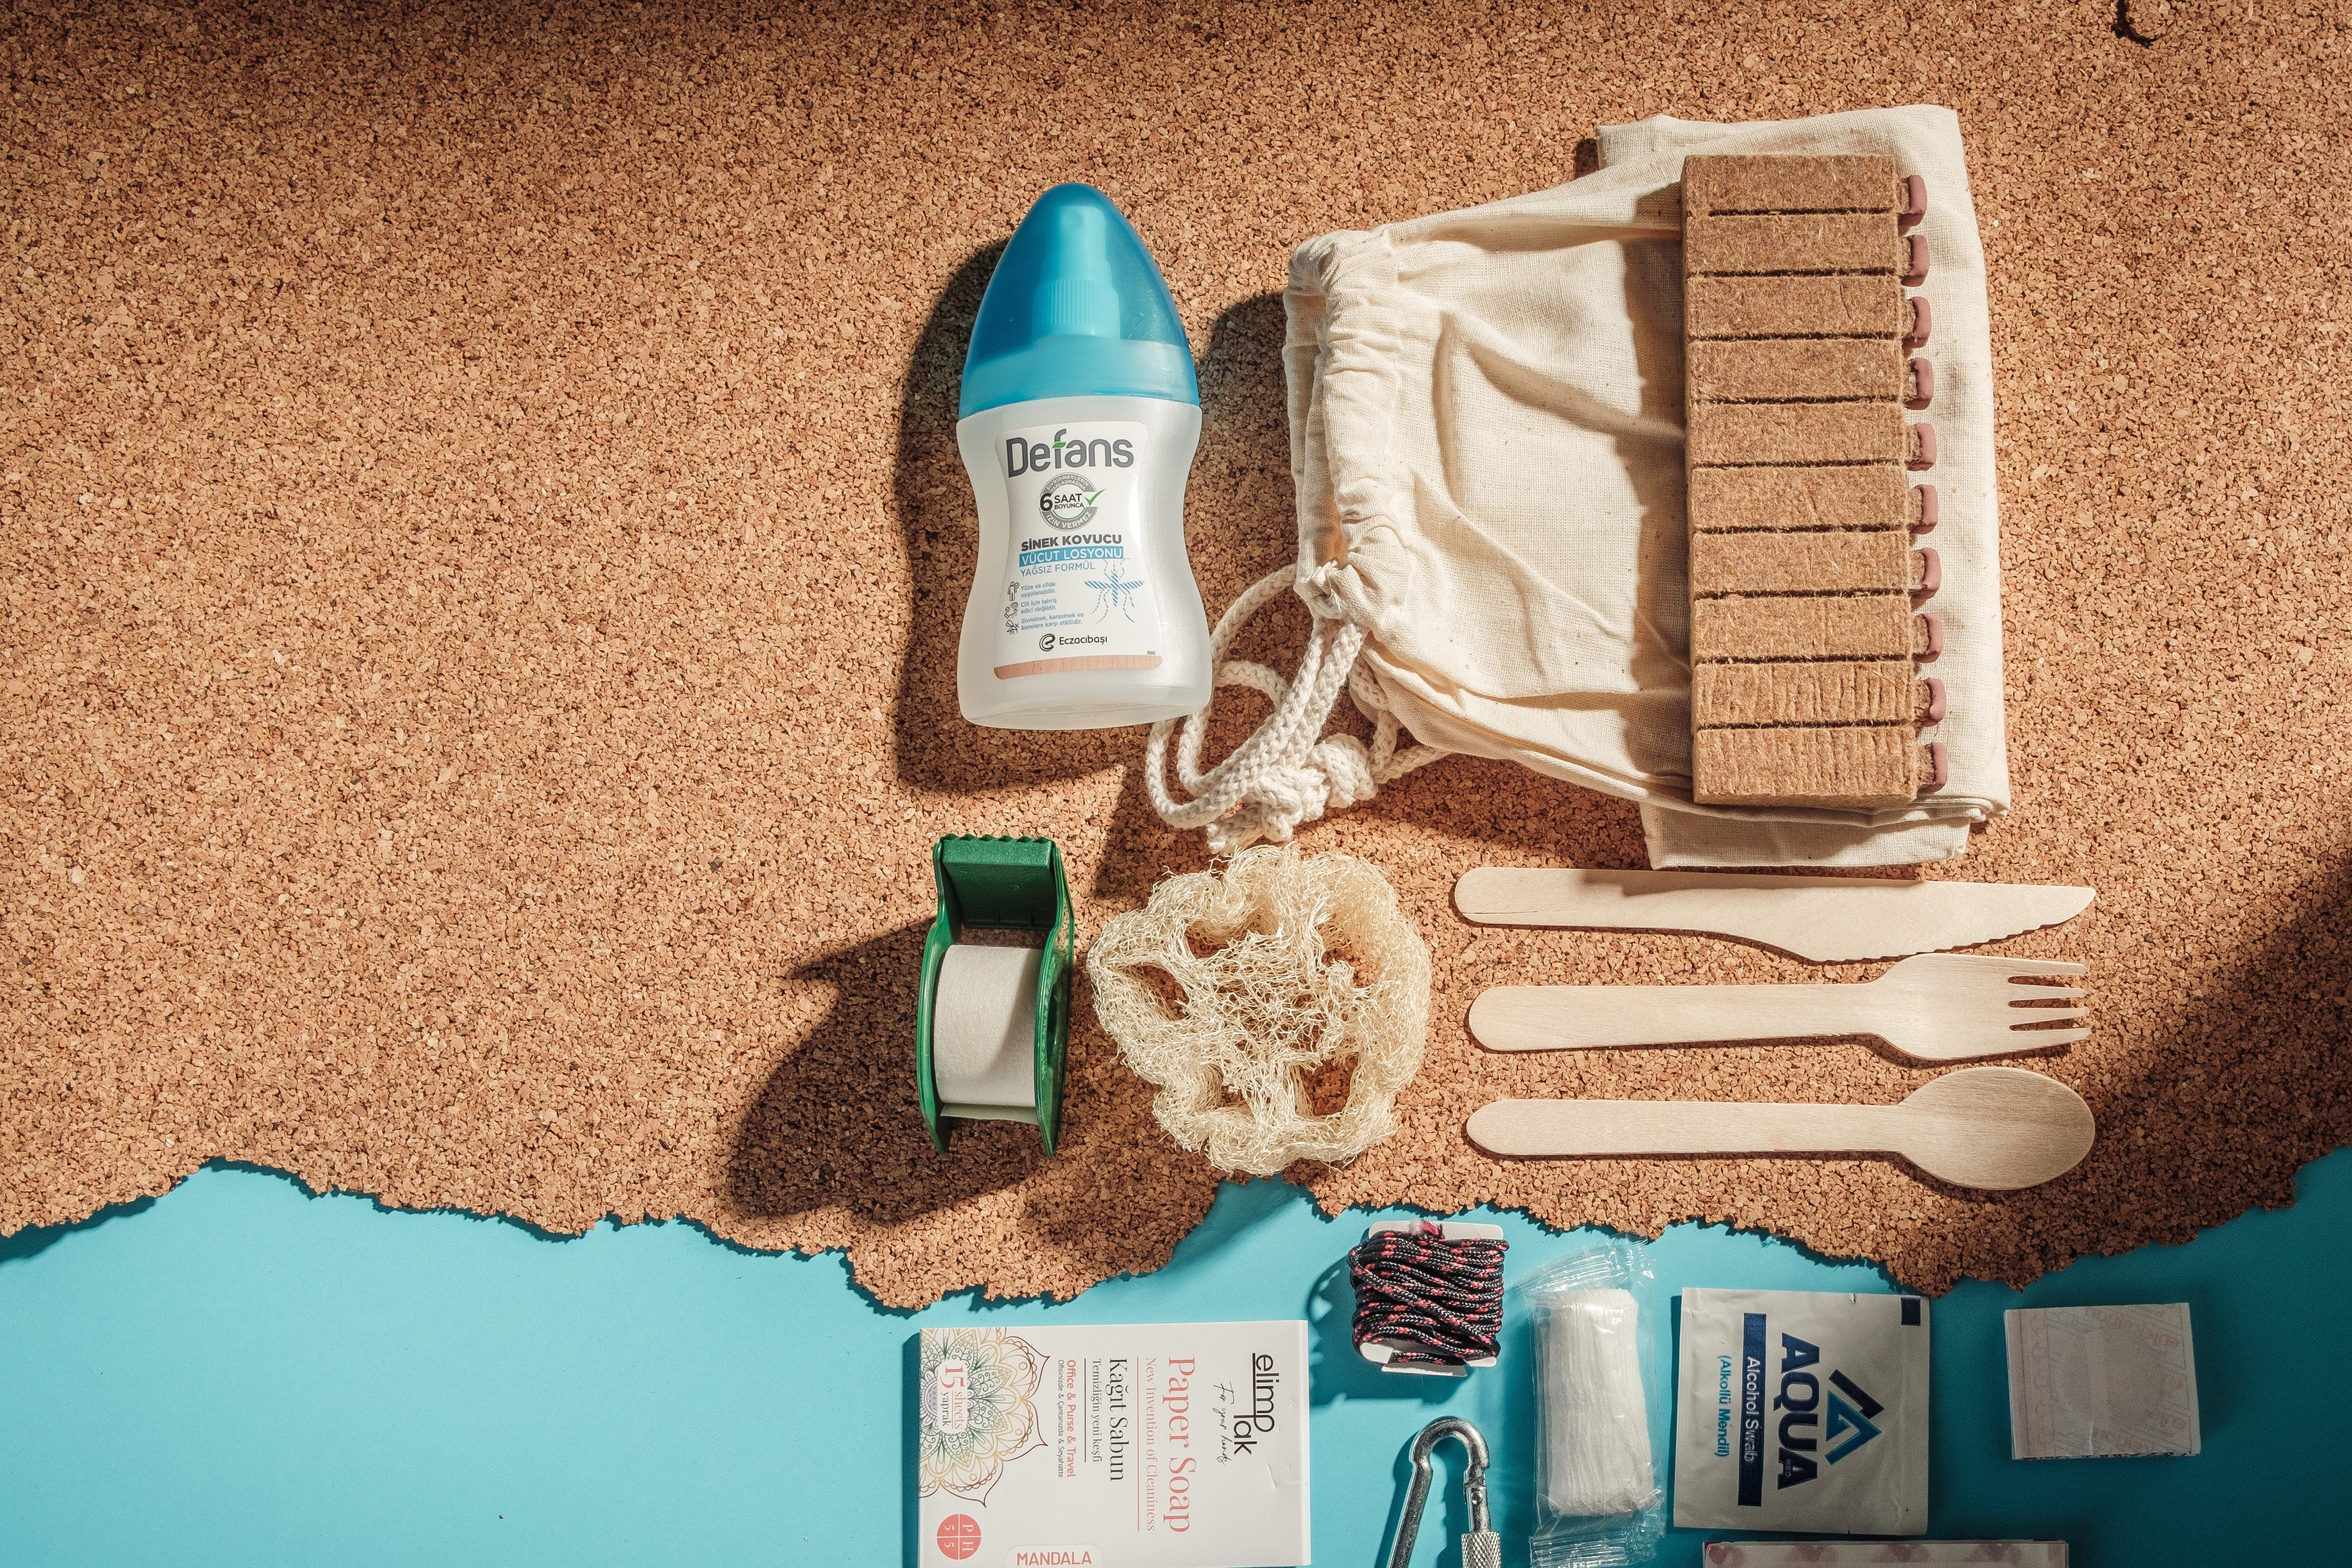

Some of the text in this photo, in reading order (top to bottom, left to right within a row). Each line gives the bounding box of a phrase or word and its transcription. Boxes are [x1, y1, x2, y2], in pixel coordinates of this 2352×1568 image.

[1006, 429, 1134, 478] Defans
[1040, 493, 1082, 511] 6 SAAT
[1062, 511, 1092, 529] VERMEZ
[1021, 534, 1122, 551] SİNEK KOVUCU
[1022, 548, 1122, 565] VÜCUT LOSYONU
[1020, 560, 1095, 577] YAĞSIZ FORMÜL
[1059, 635, 1107, 645] Eczacıbaşı
[1066, 1360, 1076, 1389] Office
[939, 1365, 966, 1429] 15 sheets
[940, 1392, 951, 1426] yaprak
[1090, 1359, 1102, 1463] Temizliğin yeni keşfi
[1714, 1355, 1733, 1457] (Alkollü Mendil)
[1744, 1356, 1760, 1461] Alcohol Swab
[1773, 1333, 1820, 1490] AQUA
[1066, 1404, 1076, 1431] Purse
[1105, 1358, 1129, 1481] Kağıt Sabun
[1212, 1381, 1235, 1465] For your hands
[1145, 1358, 1158, 1531] New Invention of Cleaniness
[1162, 1357, 1196, 1532] Paper Soap
[1056, 1447, 1065, 1478] Seyahatte
[1066, 1448, 1076, 1477] Travel
[1016, 1550, 1091, 1566] MANDALA
